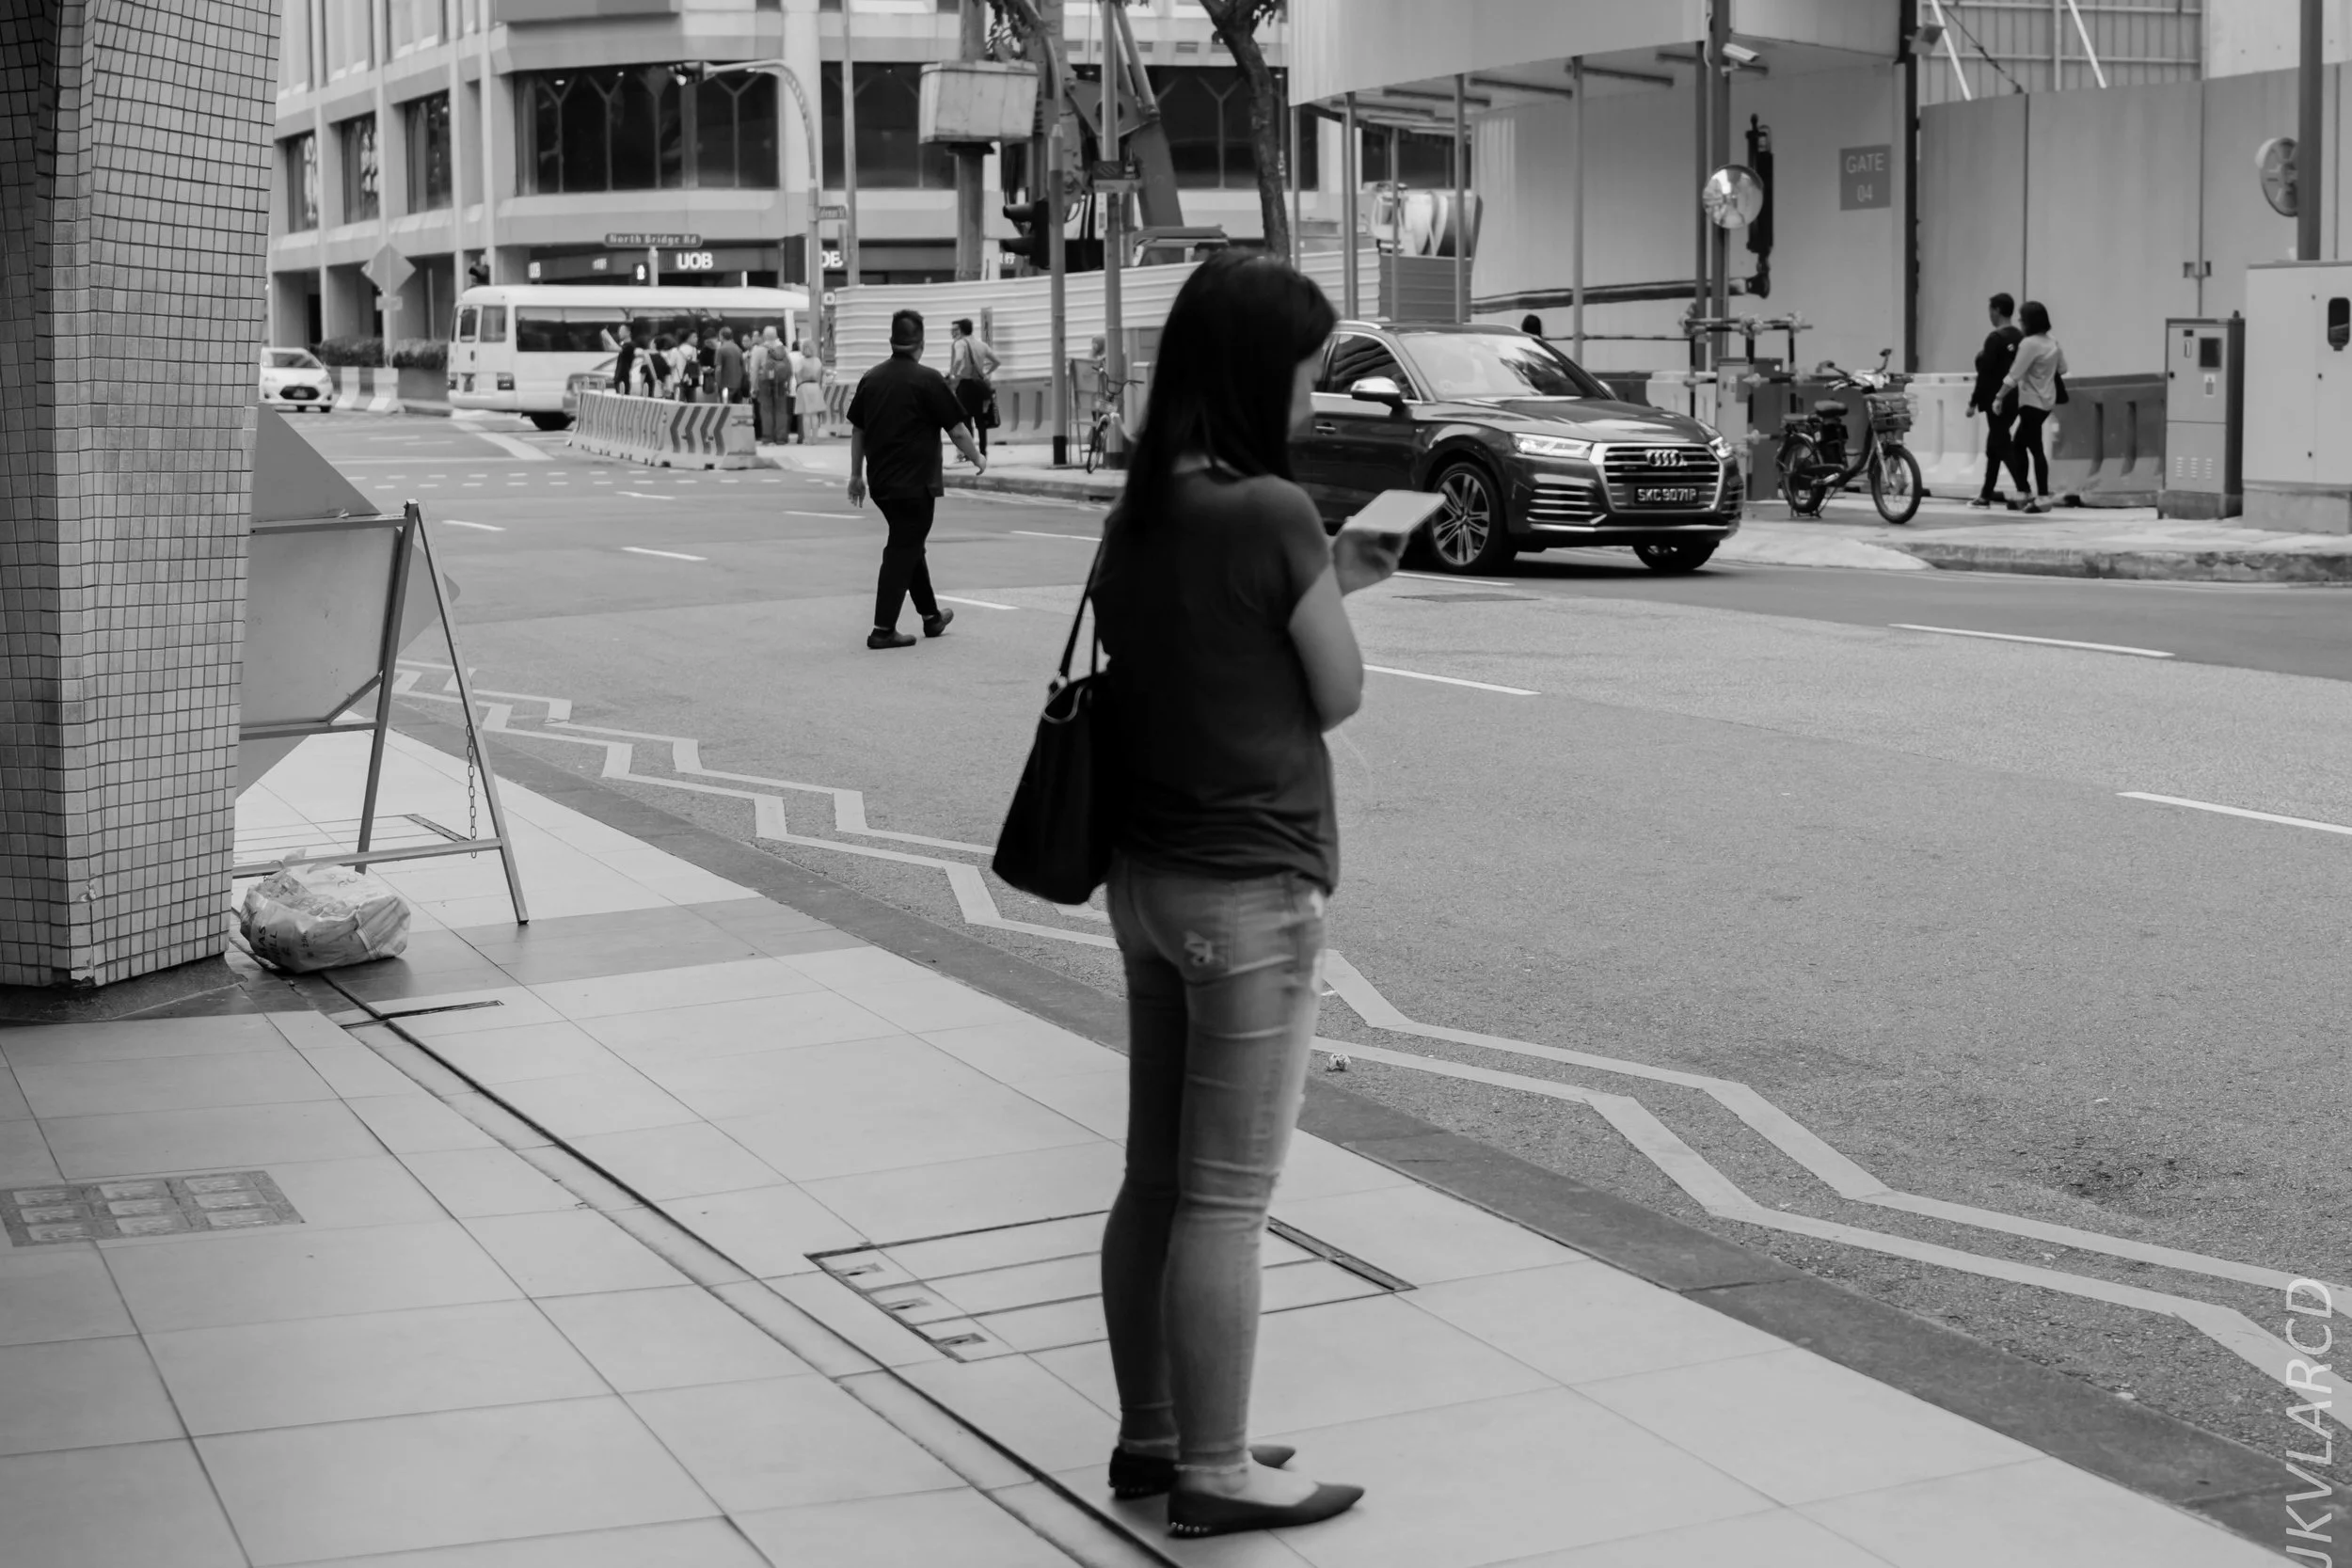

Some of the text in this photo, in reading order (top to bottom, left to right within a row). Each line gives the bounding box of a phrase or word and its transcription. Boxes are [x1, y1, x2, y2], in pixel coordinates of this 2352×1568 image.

[1846, 152, 1884, 174] GATE
[1857, 183, 1873, 202] 04
[610, 234, 697, 246] North Bridge Rd
[675, 251, 713, 270] UOB
